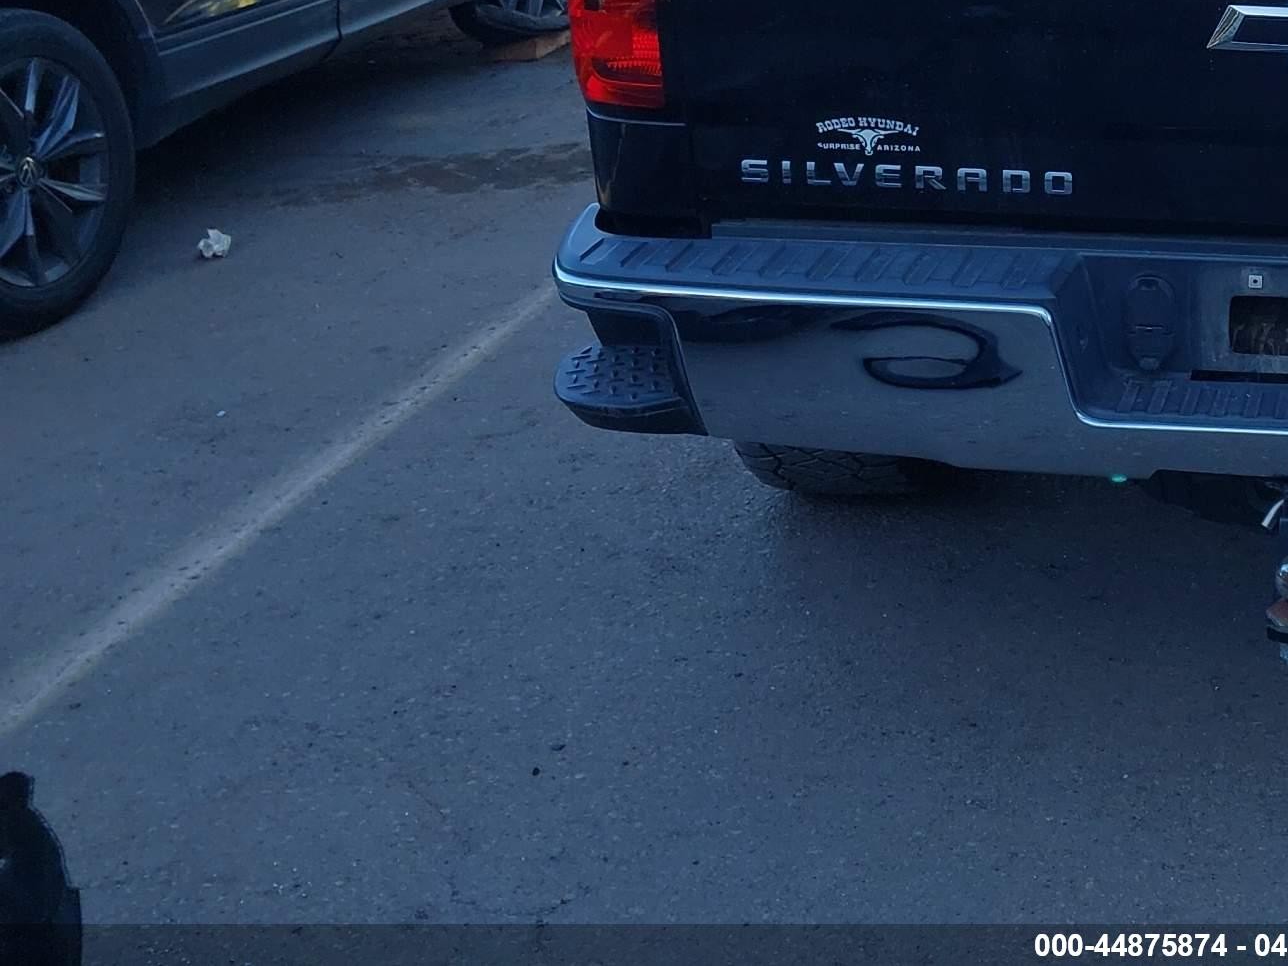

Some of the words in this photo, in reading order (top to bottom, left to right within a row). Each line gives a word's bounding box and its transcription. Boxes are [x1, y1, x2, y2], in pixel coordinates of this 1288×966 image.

[816, 117, 855, 133] RODEO
[858, 117, 919, 136] HYUNDAI
[817, 142, 860, 151] SURPRISE
[741, 159, 1073, 195] SILVERADO
